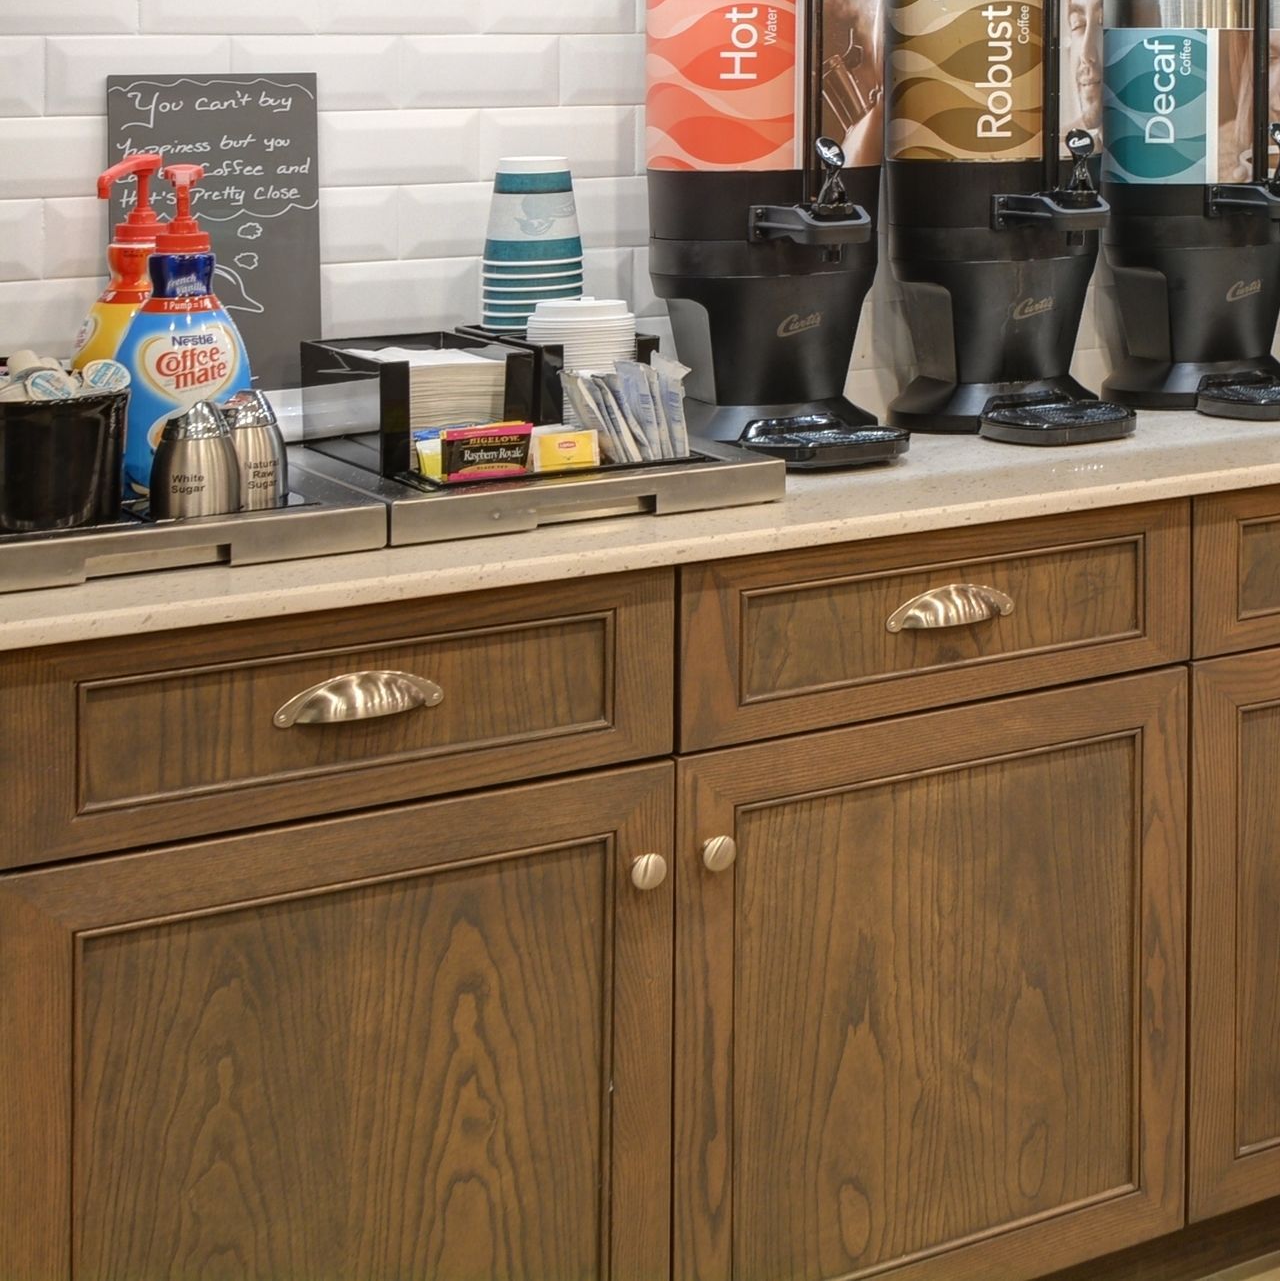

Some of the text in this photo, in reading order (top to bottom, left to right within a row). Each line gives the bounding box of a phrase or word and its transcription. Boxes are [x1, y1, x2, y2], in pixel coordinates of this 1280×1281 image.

[763, 7, 778, 46] Water
[1016, 5, 1030, 45] Coffee
[719, 6, 759, 80] Hot
[1179, 38, 1192, 76] Coffee
[974, 4, 1013, 138] Robust
[1143, 38, 1176, 145] Decaf
[121, 91, 185, 130] You
[258, 90, 293, 113] buy
[219, 133, 256, 150] but
[263, 136, 291, 152] you
[276, 156, 311, 175] and
[167, 273, 197, 289] French
[169, 300, 193, 311] Pump
[174, 361, 227, 390] mate
[469, 435, 520, 445] BIGELOW
[244, 458, 280, 470] Natural
[463, 448, 498, 462] Raspberry
[171, 474, 205, 484] White
[252, 470, 275, 479] Raw
[170, 484, 206, 495] Sugar
[247, 479, 278, 491] Sugar
